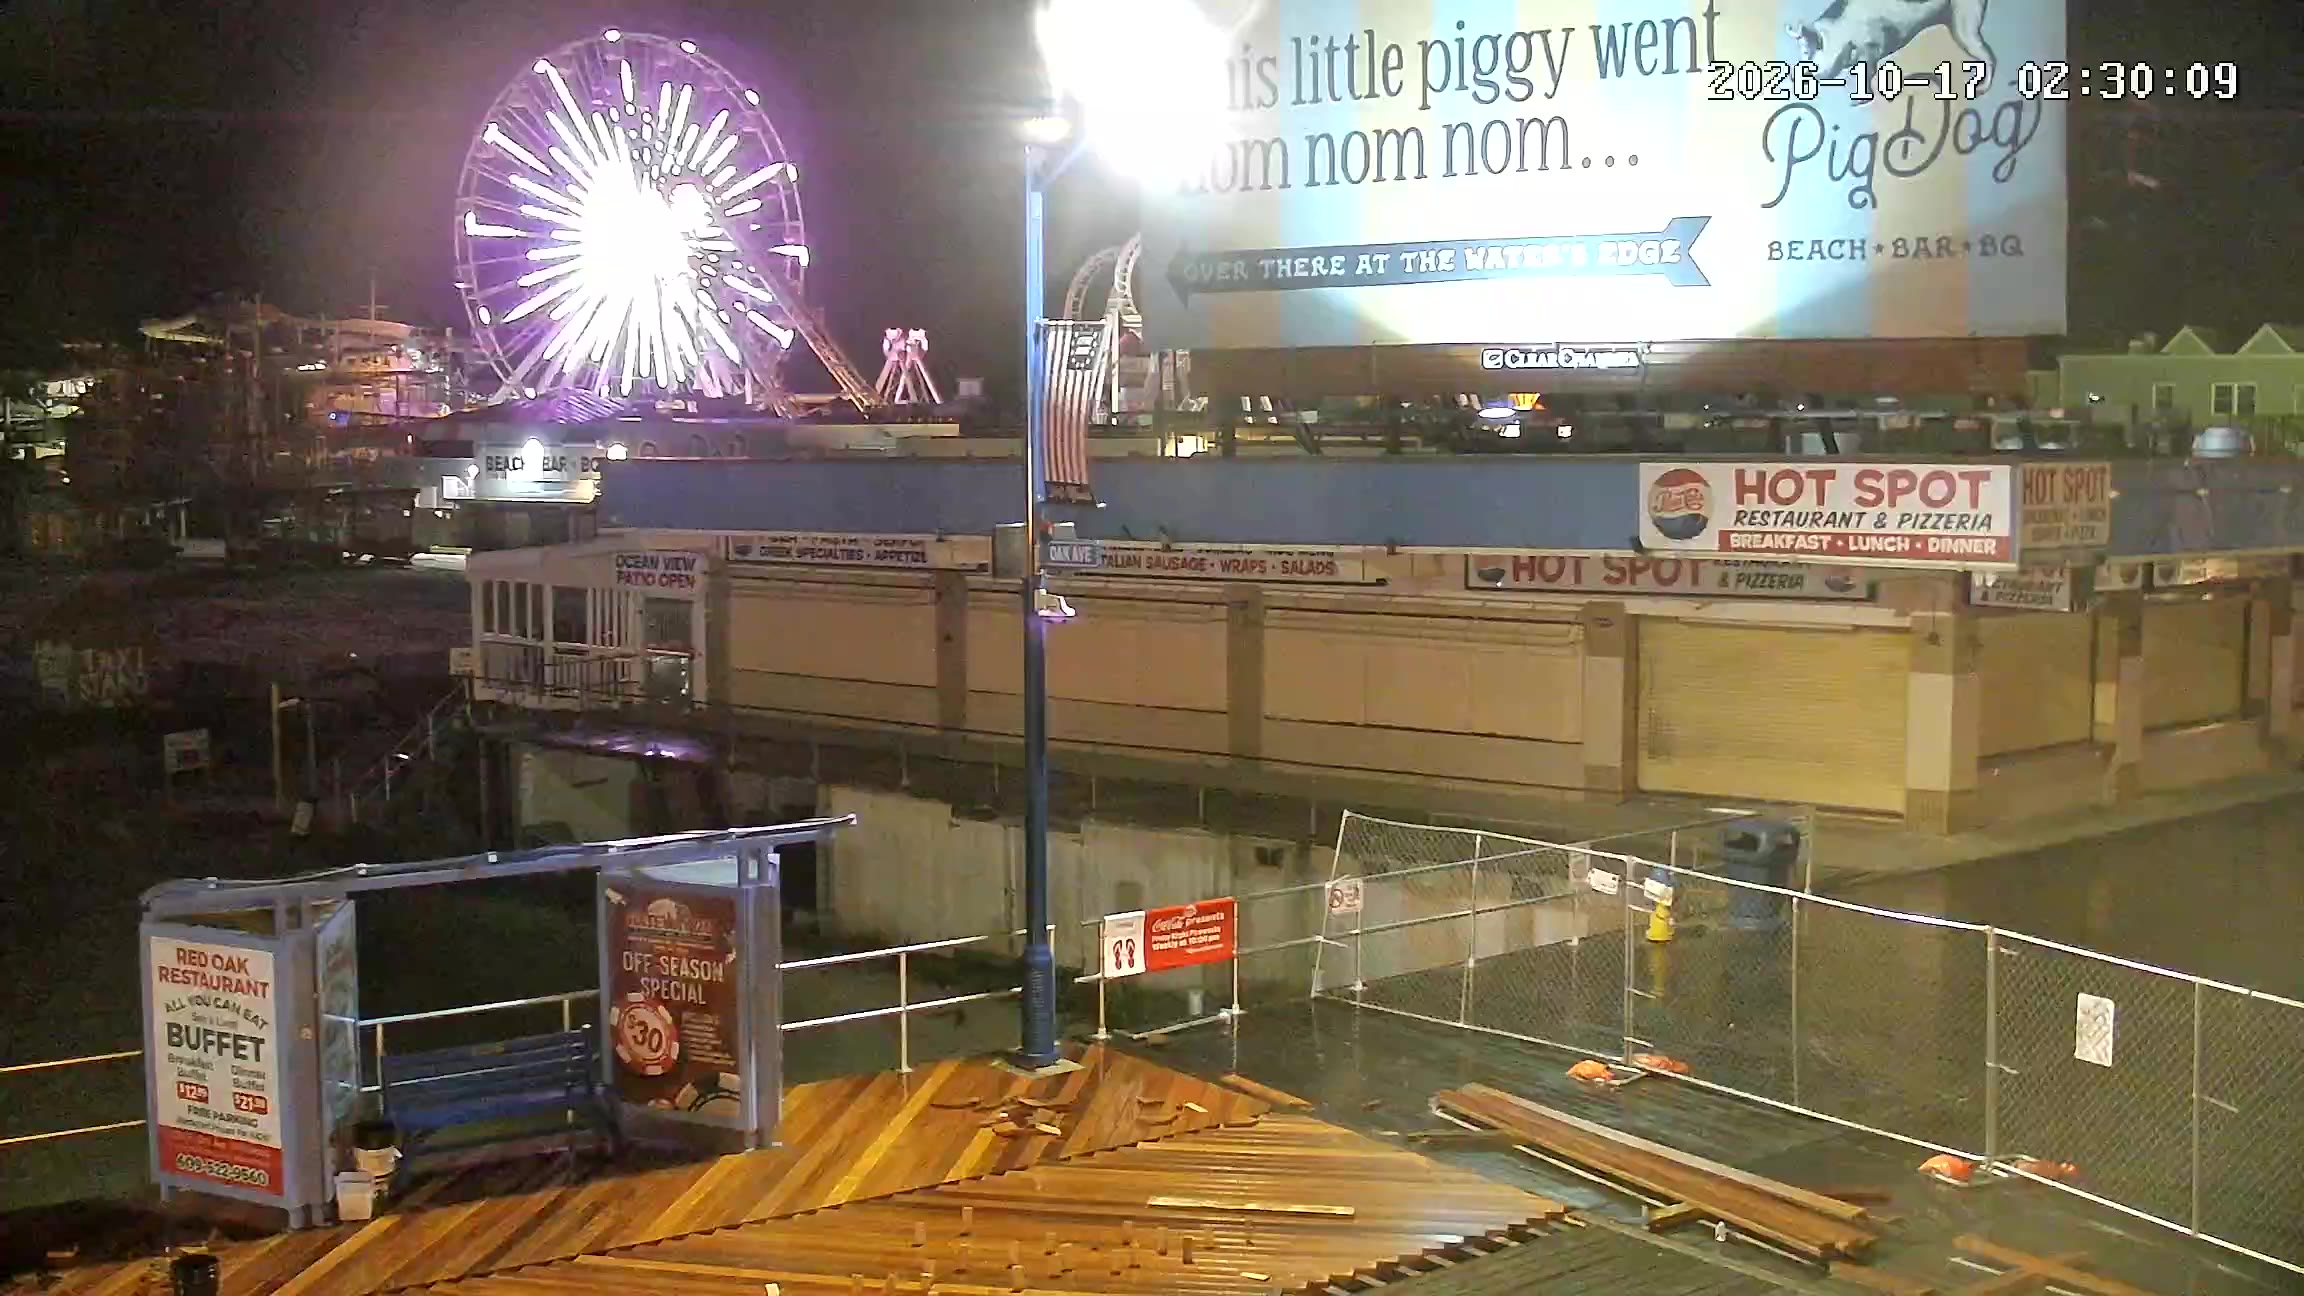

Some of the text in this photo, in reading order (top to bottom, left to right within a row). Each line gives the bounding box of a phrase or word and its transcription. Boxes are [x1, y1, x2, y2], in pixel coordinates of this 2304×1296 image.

[1226, 0, 1720, 111] is little piggy went
[1178, 115, 1638, 193] om nom nom...
[1184, 260, 1249, 282] OVER
[1259, 255, 1346, 279] THERE
[1355, 253, 1391, 275] AT
[1400, 247, 1457, 273] THE
[1597, 239, 1681, 267] EDGE
[1767, 234, 2025, 261] BEACH BAR BQ
[1733, 468, 1992, 509] HOT SPOT
[2023, 464, 2107, 505] HOT SPOT
[1733, 509, 1993, 532] RESTAURANT & PIZZERIA
[1730, 532, 1996, 555] BREAKFAST LUNCH DINNER
[615, 554, 698, 572] OCEAN VIEW
[1145, 554, 1207, 572] SAUSAGE
[1219, 557, 1267, 575] WRAPS
[1280, 559, 1335, 576] SALADS
[1512, 555, 1704, 588] HOT SPOT
[615, 571, 697, 589] PATIO OPEN
[1733, 573, 1804, 590] PIZZERIA
[176, 947, 250, 976] RED OAK
[622, 950, 725, 982] OFF SEASON
[157, 965, 270, 999] RESTAURANT
[640, 976, 707, 1005] SPECIAL
[164, 997, 187, 1013] ALL
[213, 996, 241, 1016] CAN
[243, 1007, 269, 1031] EAT
[166, 1021, 266, 1062] BUFFET
[627, 1013, 663, 1053] $30
